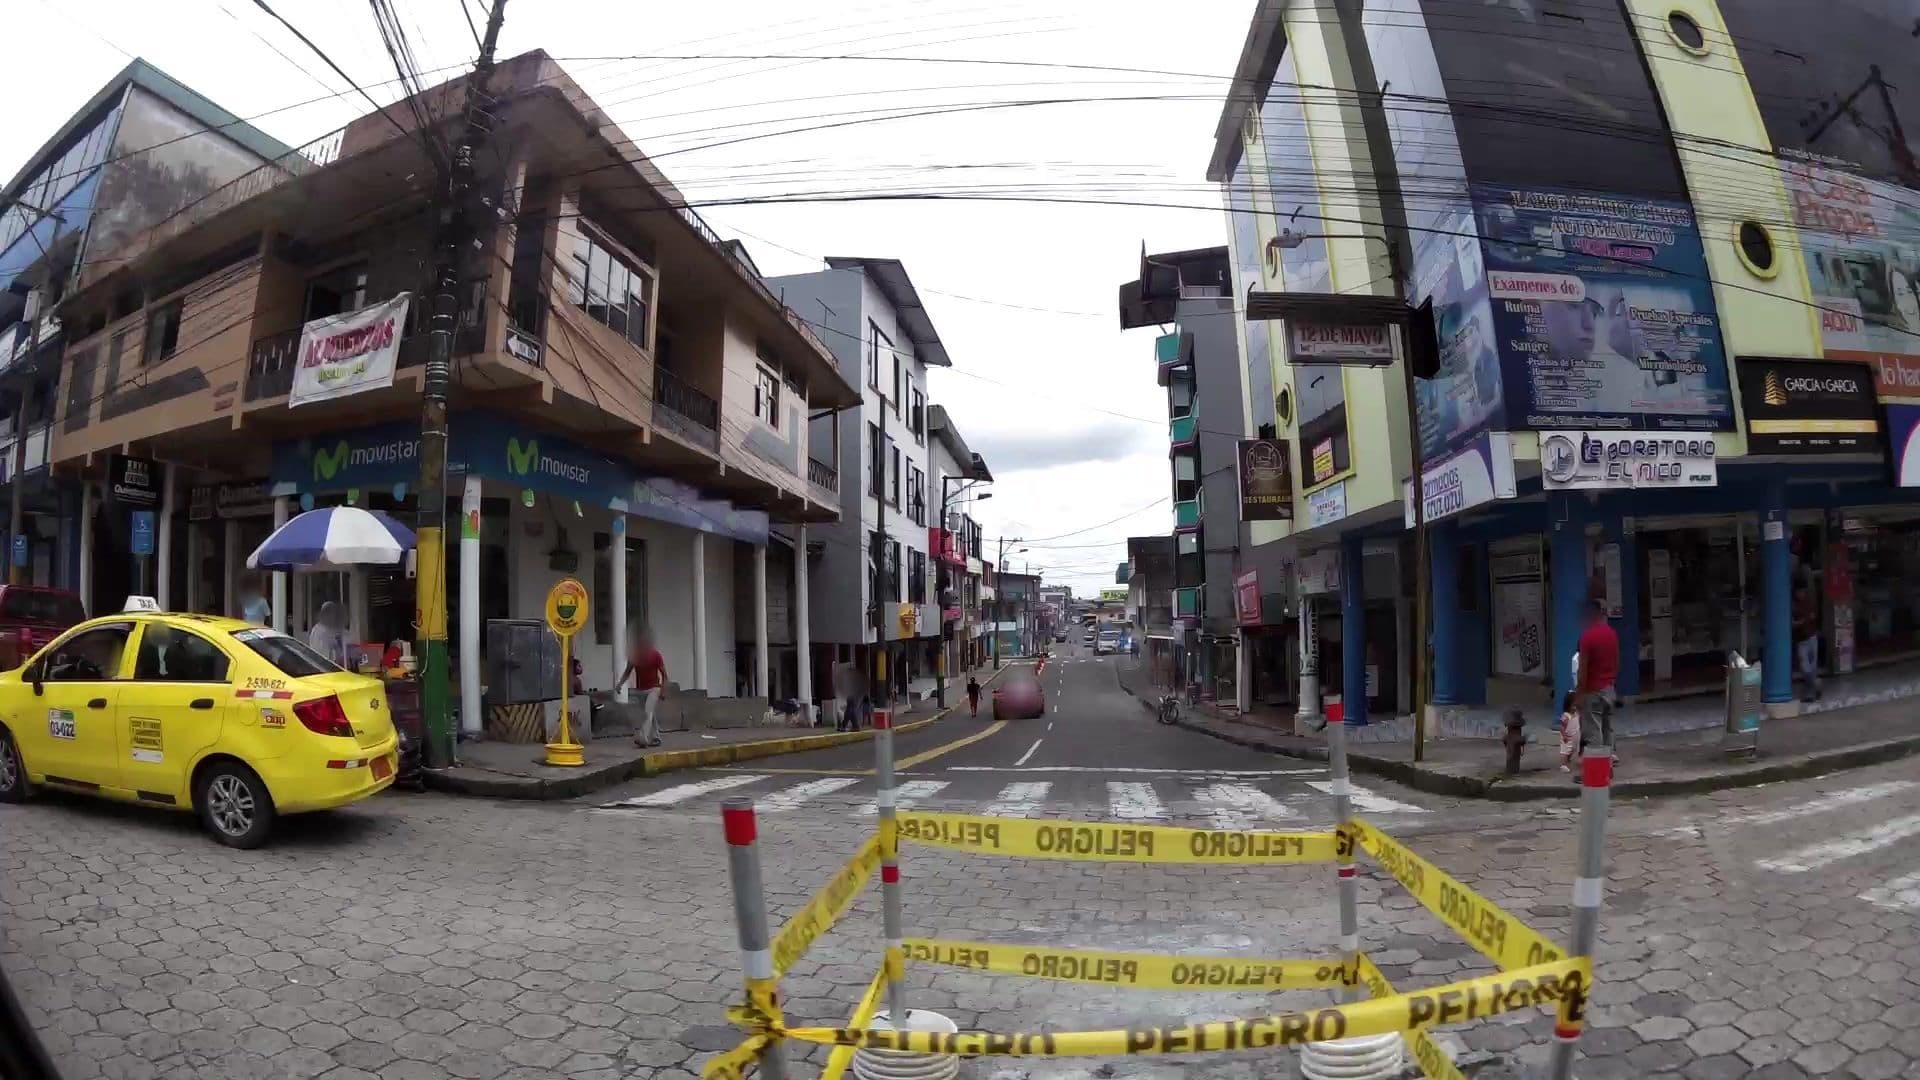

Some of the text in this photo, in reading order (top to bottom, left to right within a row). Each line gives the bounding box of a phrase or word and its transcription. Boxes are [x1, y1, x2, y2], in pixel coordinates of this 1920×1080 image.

[1511, 340, 1549, 353] Sangre
[350, 440, 420, 465] movistar
[540, 456, 590, 485] movistar
[1126, 1009, 1347, 1054] PELIGRO
